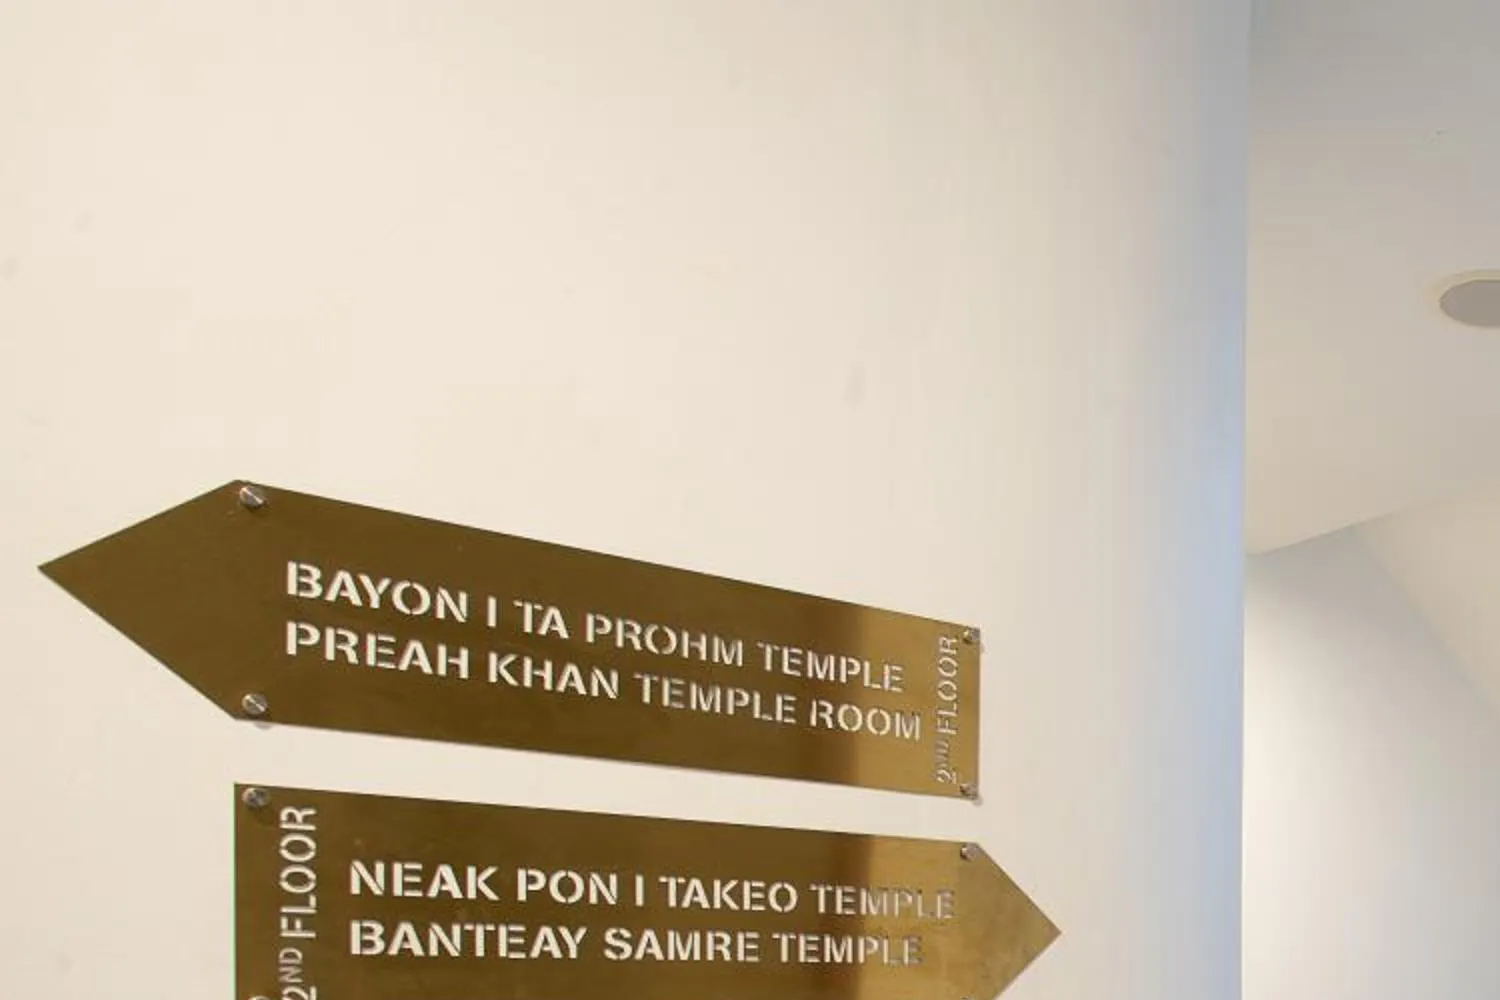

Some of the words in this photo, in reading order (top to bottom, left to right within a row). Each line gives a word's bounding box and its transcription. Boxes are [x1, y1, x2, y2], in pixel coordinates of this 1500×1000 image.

[285, 620, 470, 680] PREAH
[487, 651, 620, 700] KHAN
[632, 672, 798, 725] TEMPLE
[808, 699, 922, 742] ROOM
[286, 560, 470, 623] BAYON
[513, 600, 570, 640] TA
[584, 612, 744, 668] PROHM
[756, 641, 905, 693] TEMPLE
[937, 636, 959, 735] FLOOR
[279, 805, 317, 939] FLOOR
[350, 860, 499, 901] NEAK
[516, 867, 619, 905] PON
[658, 875, 799, 913] TAKEO
[809, 883, 956, 920] TEMPLE
[350, 919, 587, 960] BANTEAY
[602, 927, 761, 962] SAMRE
[772, 932, 926, 966] TEMPLE
